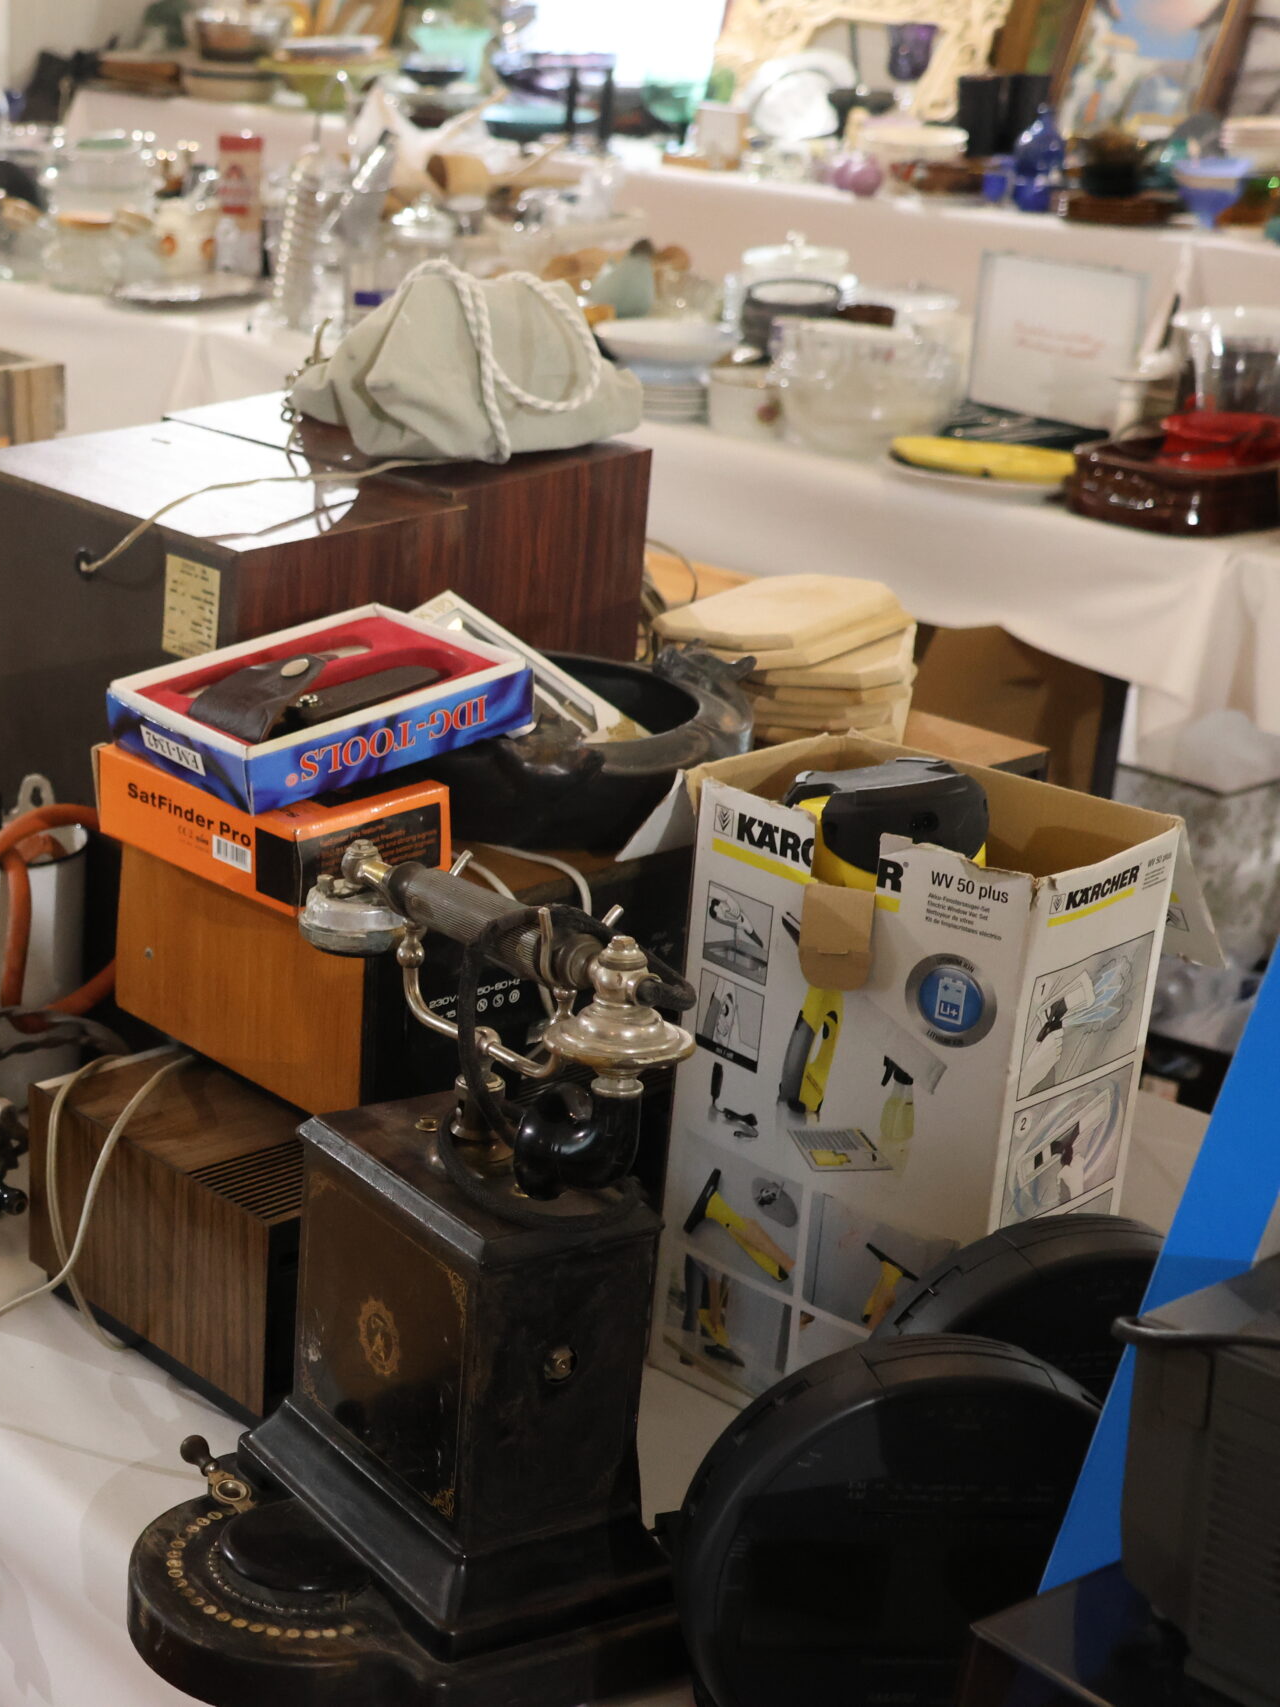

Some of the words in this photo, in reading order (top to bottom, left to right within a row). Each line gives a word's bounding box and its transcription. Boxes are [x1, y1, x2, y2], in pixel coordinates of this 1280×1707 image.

[300, 695, 488, 782] IDG-TOOLS
[128, 783, 214, 830] SatFinder
[220, 821, 251, 847] Pro
[931, 870, 954, 889] WV
[957, 878, 975, 895] 50
[979, 885, 1009, 904] plus
[1065, 865, 1140, 910] KÄRCHER
[1040, 982, 1046, 996] 1
[1020, 1116, 1027, 1131] 2
